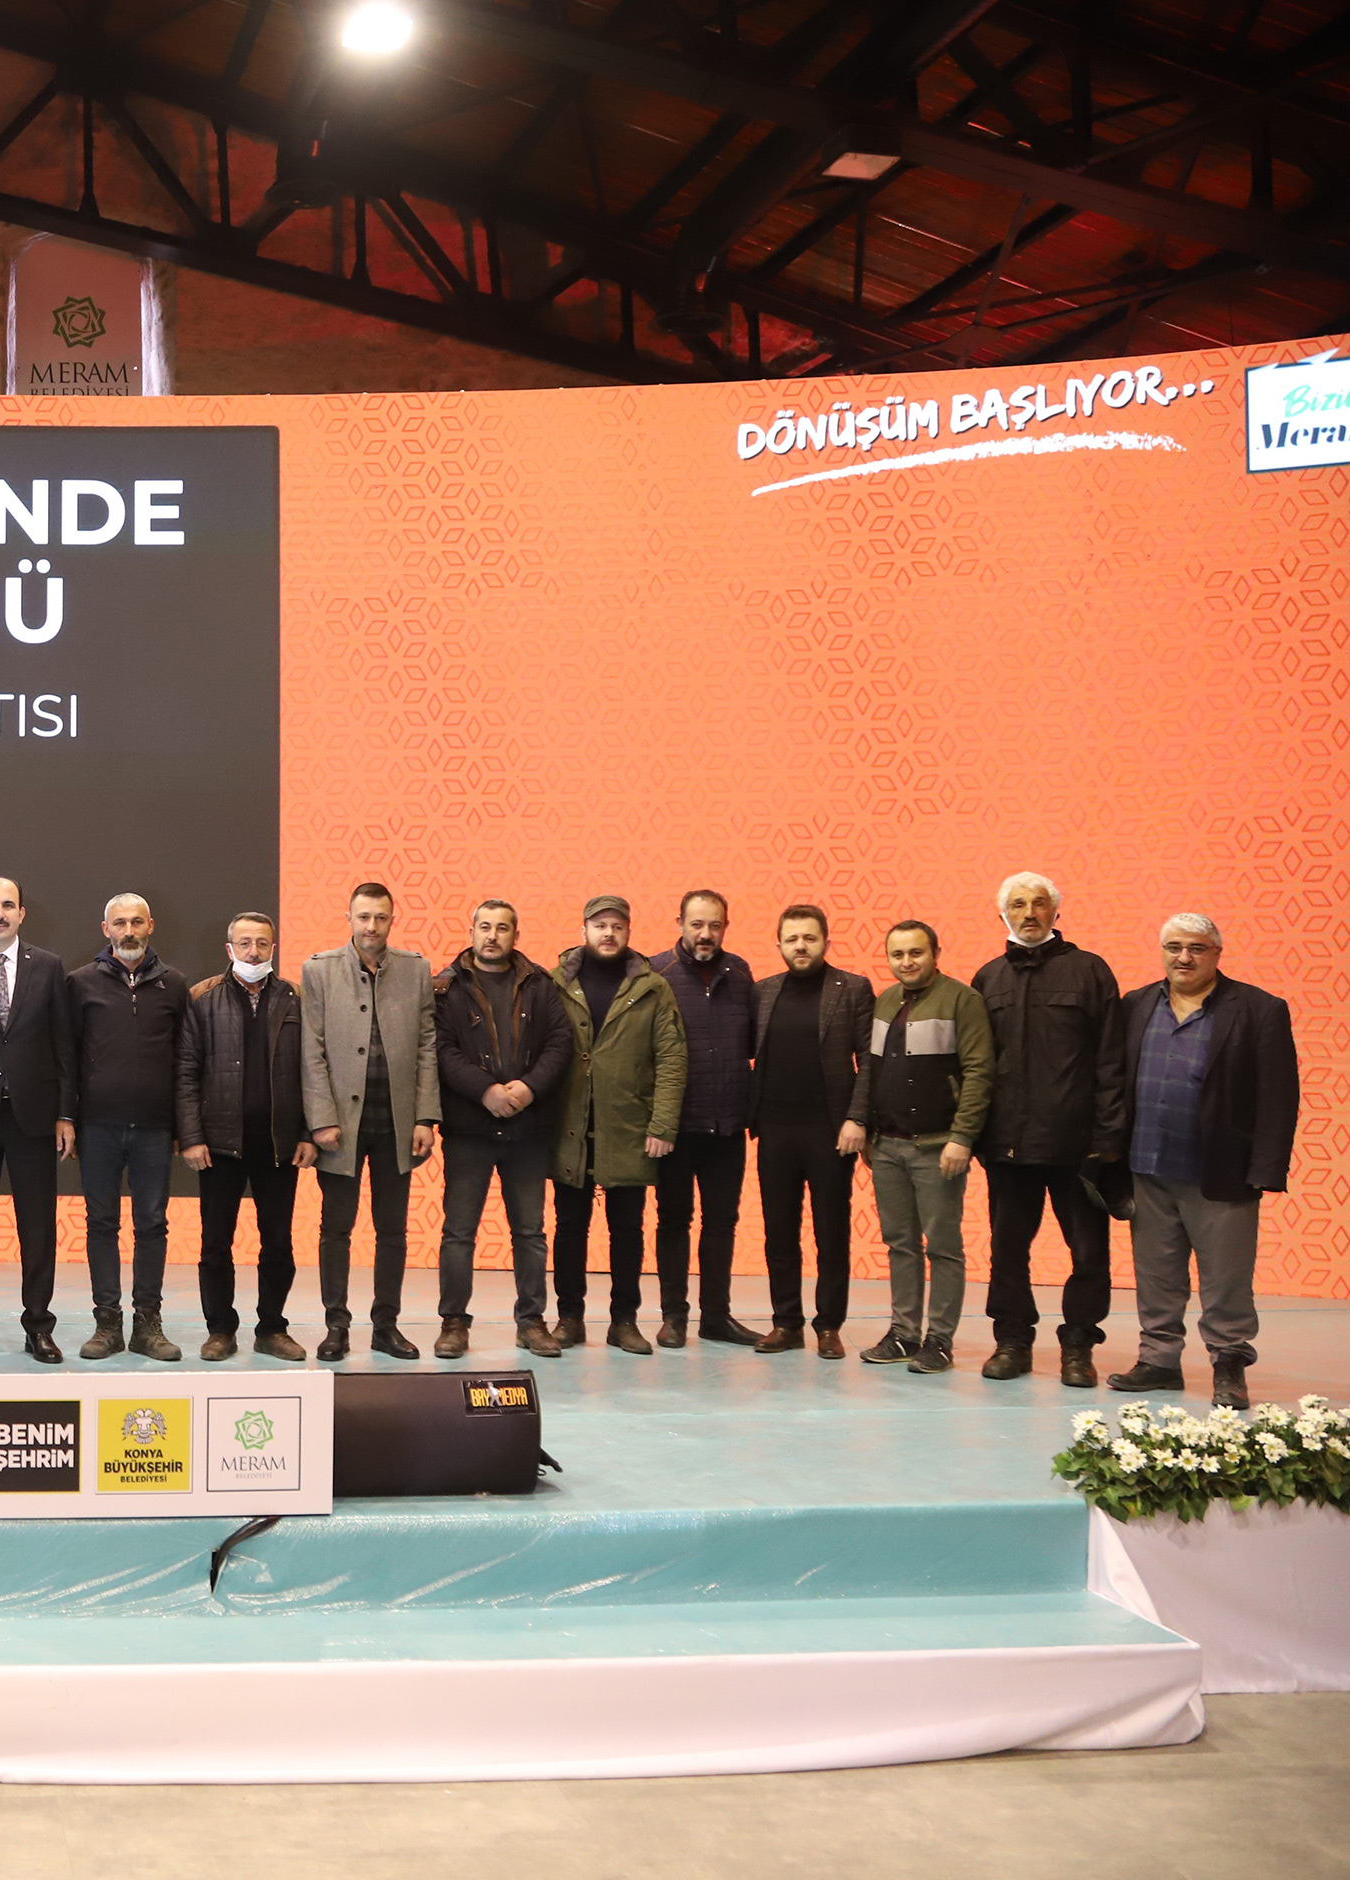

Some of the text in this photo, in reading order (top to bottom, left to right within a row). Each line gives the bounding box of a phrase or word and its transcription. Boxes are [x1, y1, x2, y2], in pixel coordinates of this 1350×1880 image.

[30, 361, 130, 384] MERAM
[1282, 384, 1350, 418] Bizi
[736, 396, 940, 461] DÖNÜŞÜM
[1256, 421, 1350, 450] Mera
[124, 1448, 164, 1460] KONYA
[104, 1460, 184, 1475] BÜYÜKŞEHİR
[220, 1456, 287, 1472] MERAM
[120, 1475, 168, 1484] BELEDİYESİ
